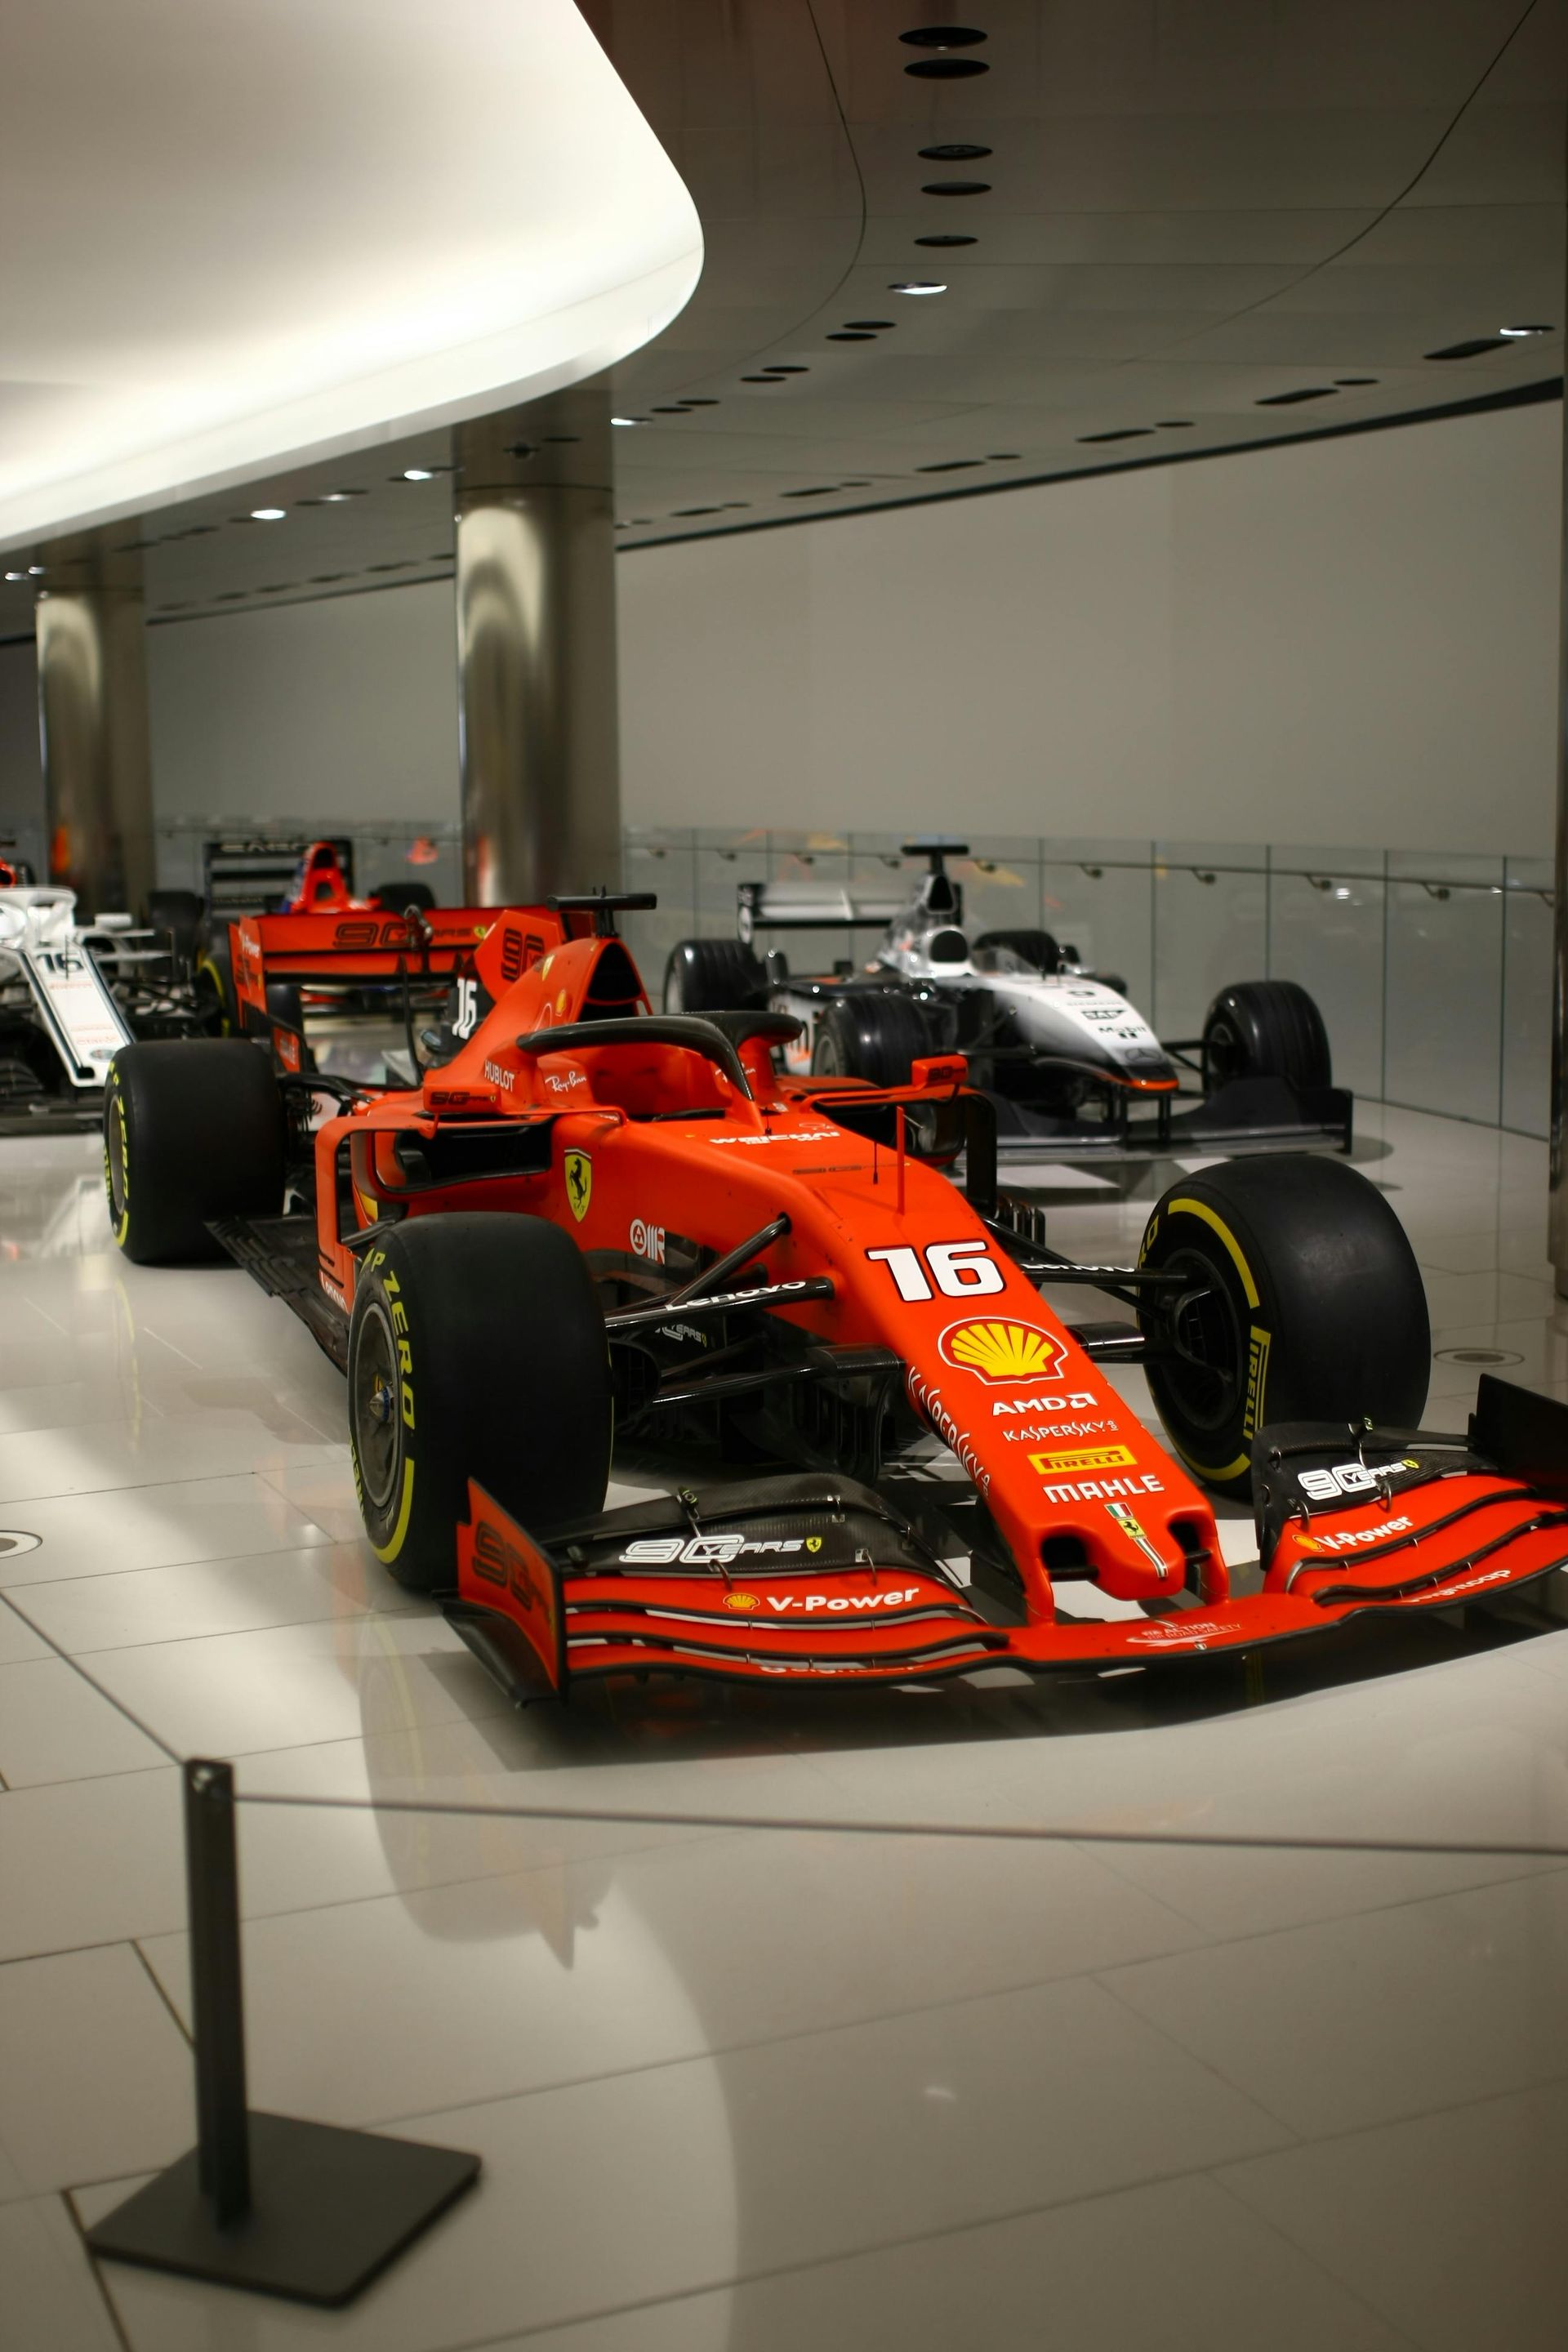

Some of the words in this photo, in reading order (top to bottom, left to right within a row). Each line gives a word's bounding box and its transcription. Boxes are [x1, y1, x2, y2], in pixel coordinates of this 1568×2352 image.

[452, 978, 477, 1040] 16
[483, 1060, 514, 1093] HUBLOT
[545, 1071, 586, 1092] Ray-Ban
[864, 1239, 1007, 1302] 16
[665, 1281, 807, 1312] Lenovo
[383, 1270, 416, 1430] ZERO
[1243, 1325, 1271, 1441] PIRELLI
[992, 1396, 1067, 1416] AMD
[1002, 1421, 1106, 1442] KASPERSKY
[1039, 1450, 1125, 1470] PIRELLI
[1043, 1474, 1165, 1503] MAHLE
[1298, 1463, 1378, 1501] 90
[1343, 1462, 1407, 1484] YEARS
[1313, 1516, 1414, 1551] V-Power
[618, 1535, 745, 1564] 90
[702, 1539, 804, 1556] YEARS
[766, 1588, 920, 1612] V-Power
